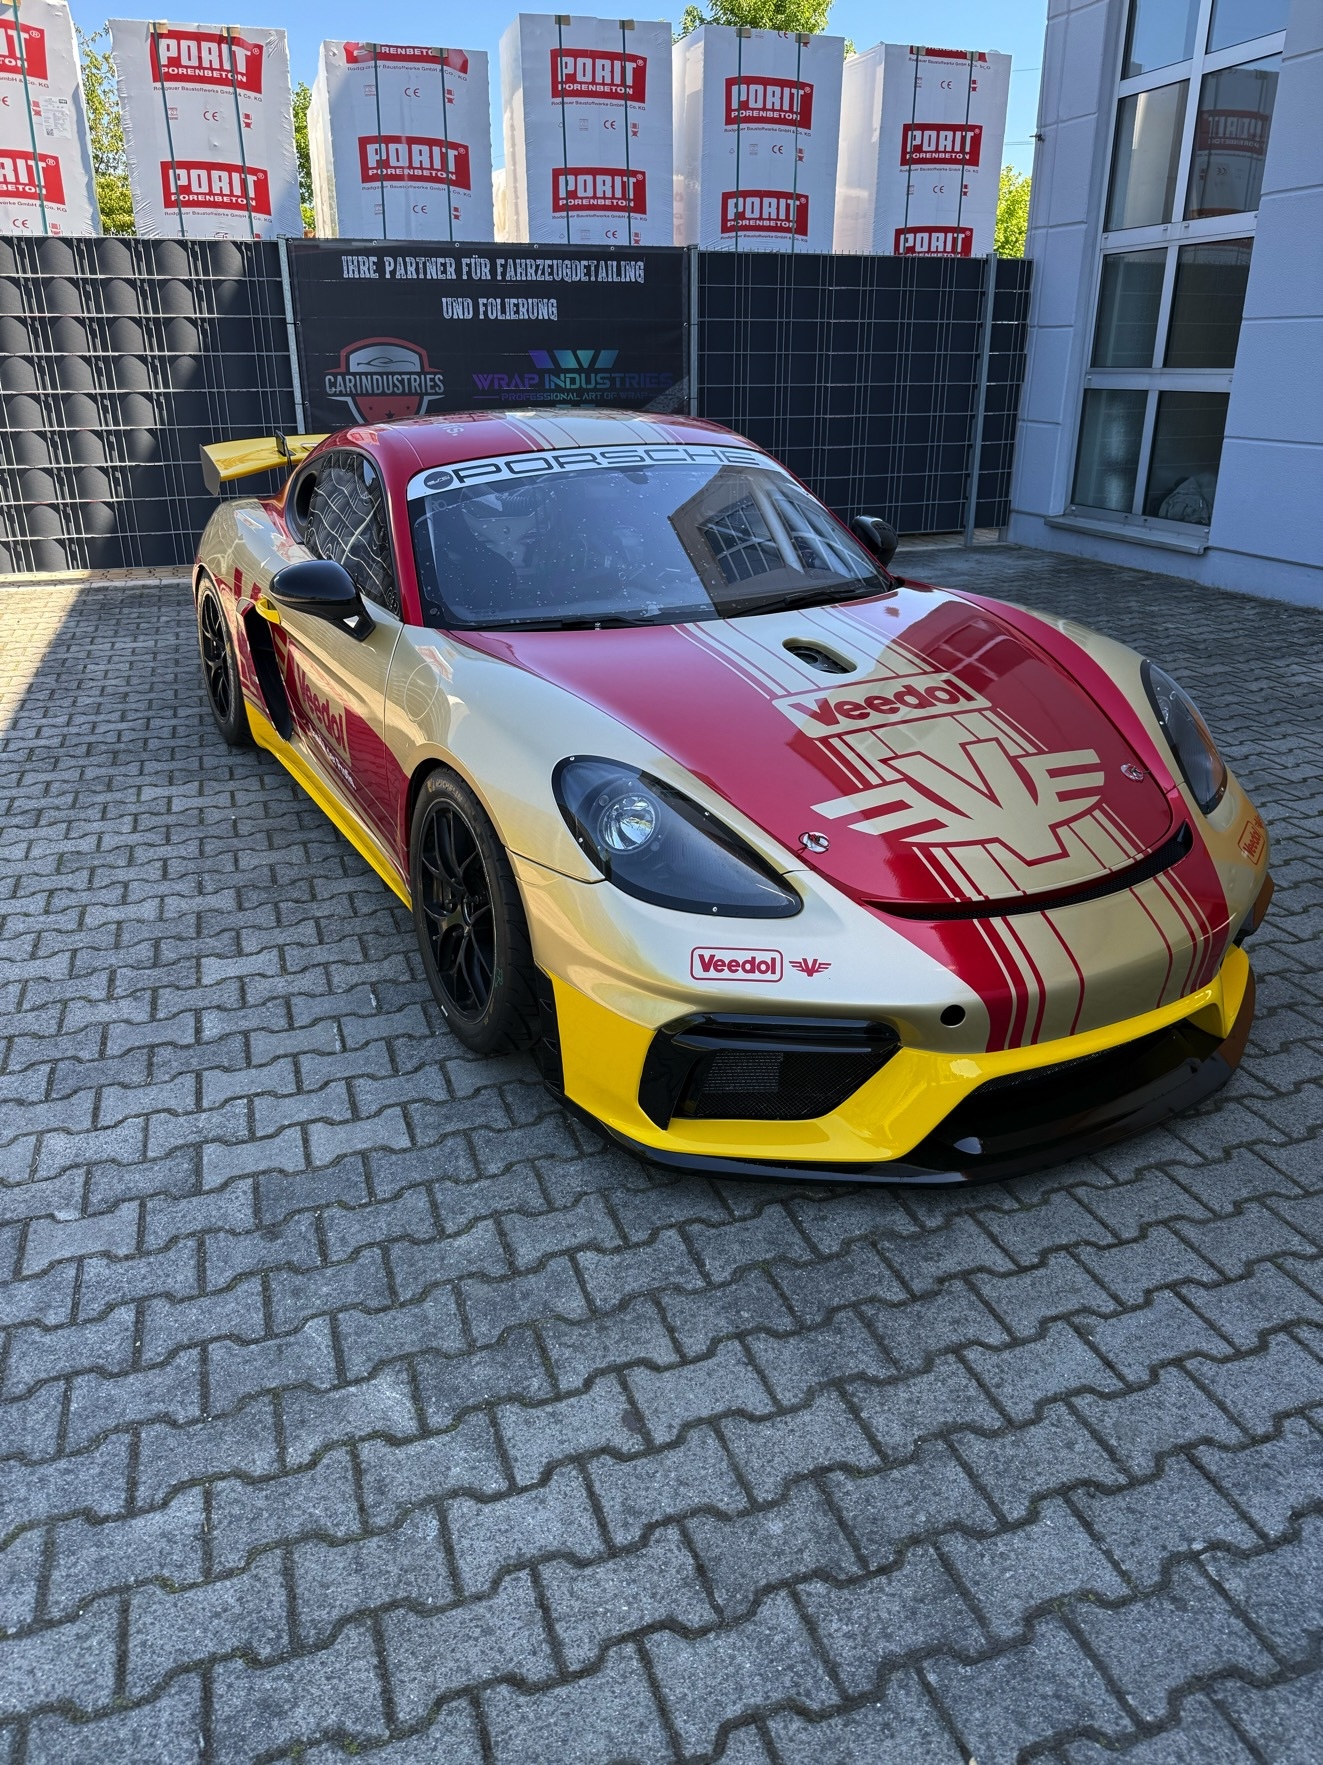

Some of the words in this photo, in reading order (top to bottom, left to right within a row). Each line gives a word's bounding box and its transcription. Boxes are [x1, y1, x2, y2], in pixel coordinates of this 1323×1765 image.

[158, 38, 252, 74] PORIT
[558, 56, 637, 86] PORIT
[731, 84, 804, 113] PORIT
[906, 130, 974, 153] PORIT
[366, 143, 458, 173] PORIT
[168, 168, 257, 199] PORIT
[368, 168, 456, 180] PORENBETON
[558, 174, 637, 200] PORIT
[727, 197, 800, 221] PORIT
[899, 232, 965, 253] PORIT
[341, 255, 379, 279] IHRE
[384, 256, 457, 281] PARTNER
[461, 254, 491, 281] FÜR
[496, 257, 645, 284] FAHRZEUGDETAILING
[441, 297, 473, 320] UND
[478, 297, 558, 321] FOLIERUNG
[324, 373, 445, 395] CARINDUSTRIES
[472, 373, 539, 391] WRAP
[544, 373, 674, 389] INDUSTRIES
[501, 392, 581, 401] PROFESSIONAL
[582, 391, 602, 400] ART
[603, 391, 617, 400] OF
[451, 449, 760, 484] PORSCHE
[788, 678, 979, 727] Veedol
[697, 953, 777, 975] Veedol
